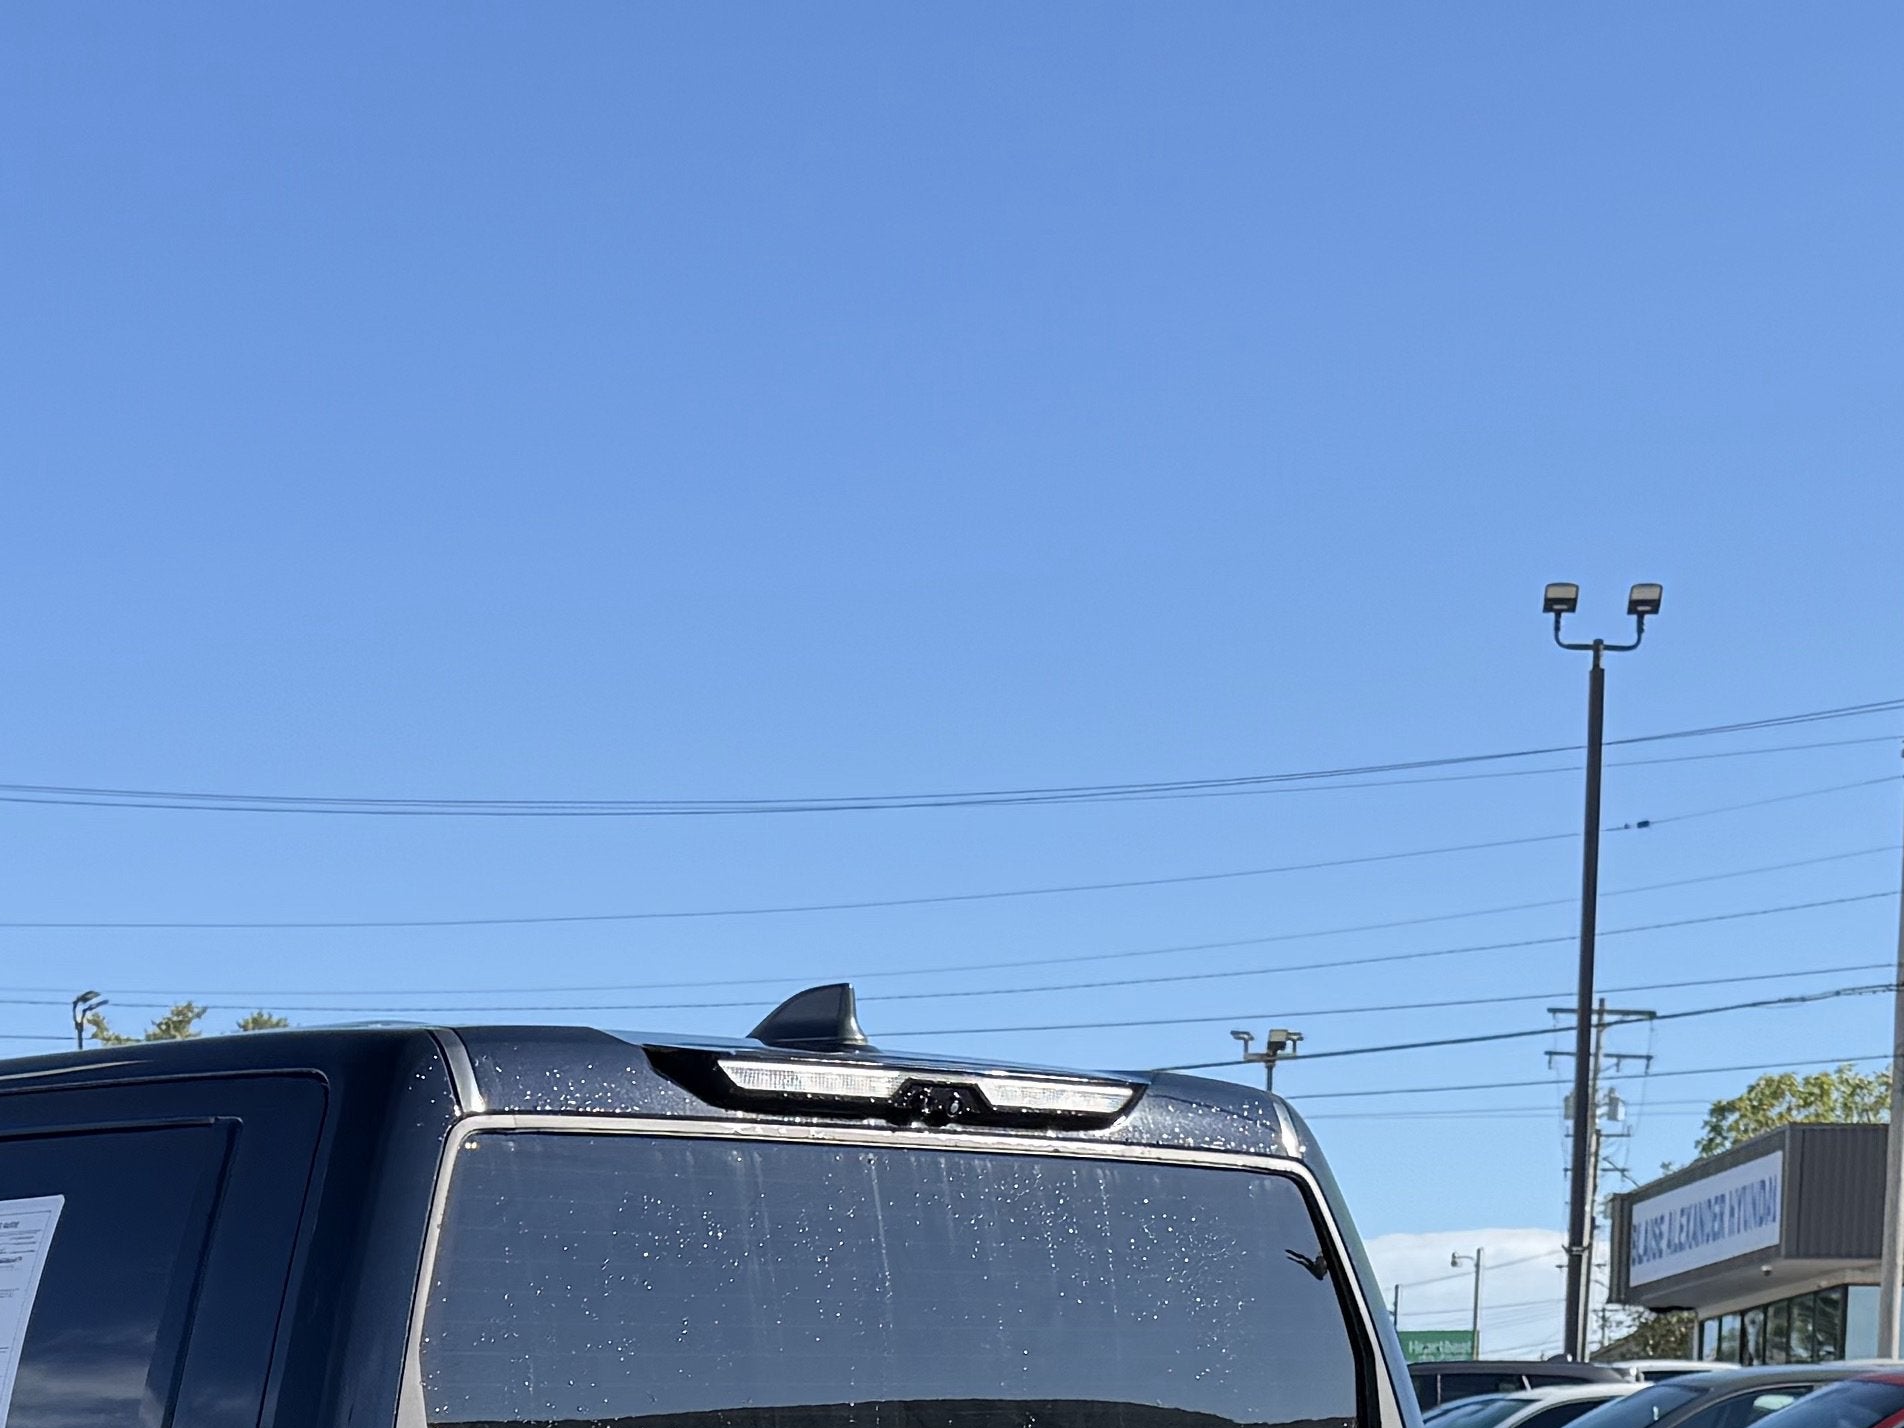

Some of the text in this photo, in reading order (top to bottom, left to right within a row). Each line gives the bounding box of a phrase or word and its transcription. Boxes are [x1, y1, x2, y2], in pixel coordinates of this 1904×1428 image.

[1631, 1174, 1778, 1267] BLAISE ALEXANDER HYUNDAI
